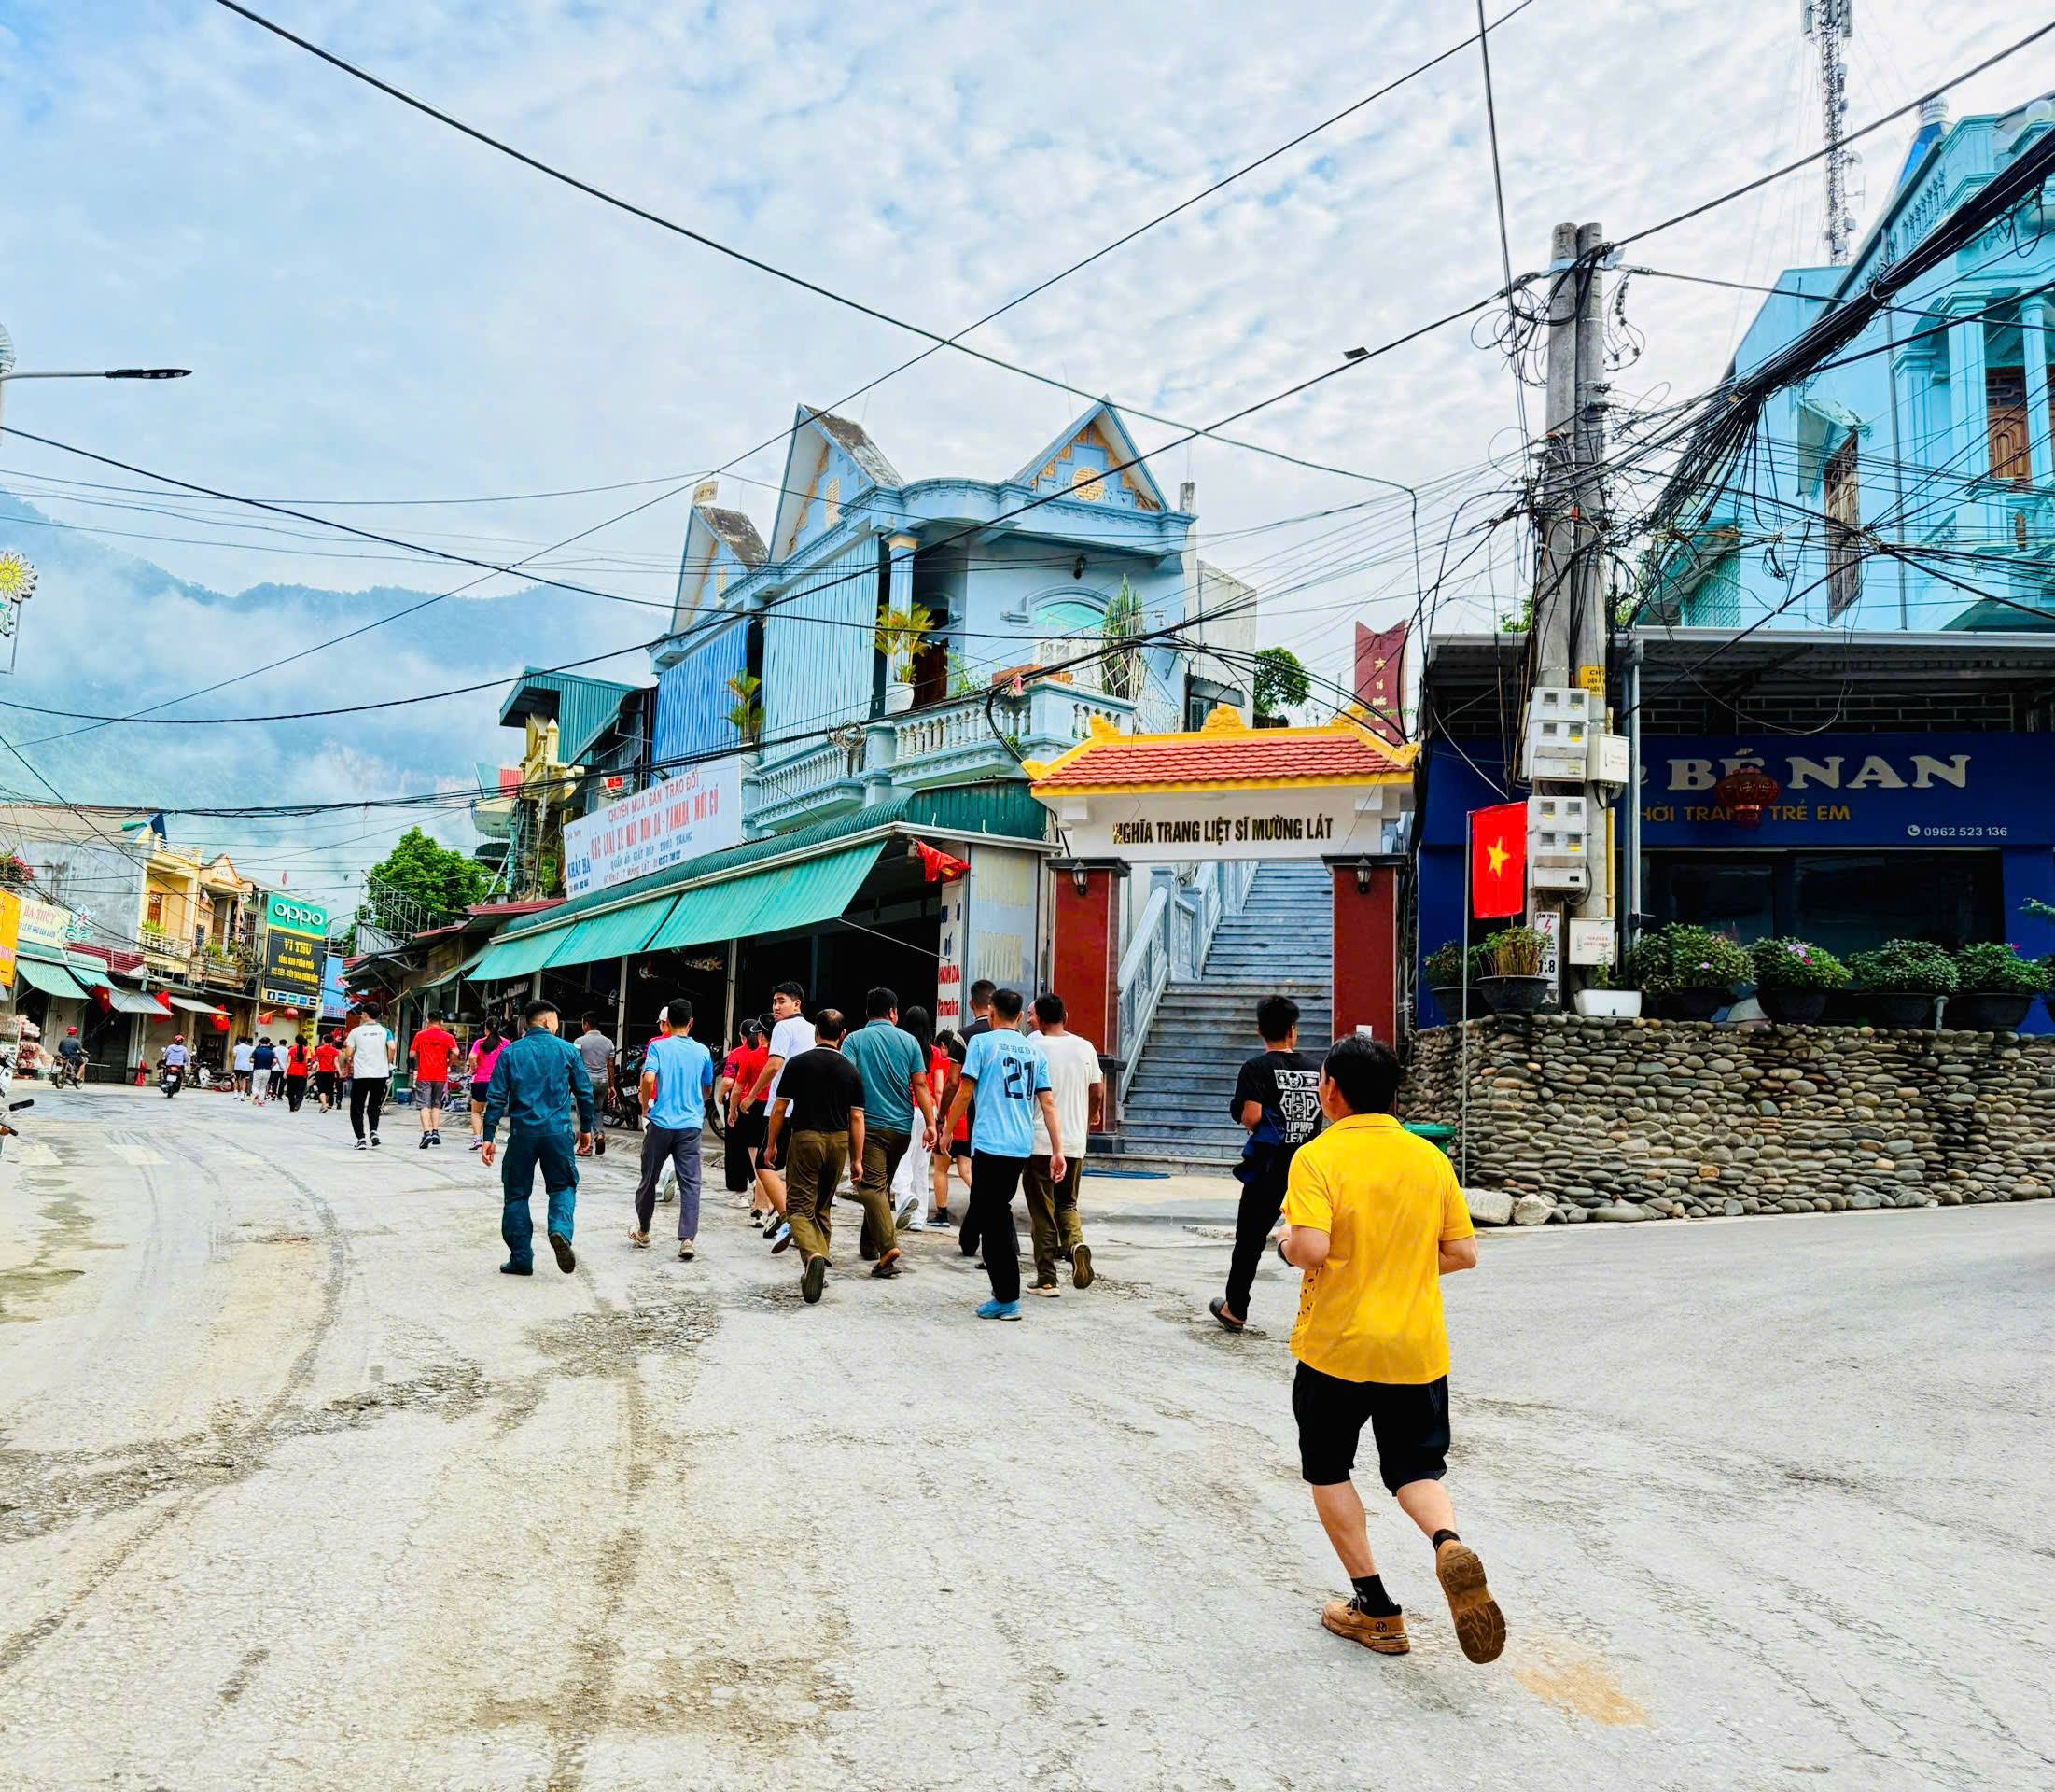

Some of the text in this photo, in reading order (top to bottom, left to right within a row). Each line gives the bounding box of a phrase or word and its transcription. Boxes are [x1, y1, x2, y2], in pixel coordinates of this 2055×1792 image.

[1785, 754, 1972, 790] NAN
[665, 778, 684, 799] TRAO
[1768, 798, 1808, 821] TRẺ
[1816, 805, 1852, 821] EM
[1113, 813, 1334, 846] NGHĨA TRANG LIỆT SĨ MƯỜNG LÁT
[1923, 826, 2008, 837] 0962 523 136
[274, 903, 324, 926] oppo
[1003, 1057, 1034, 1100] 21
